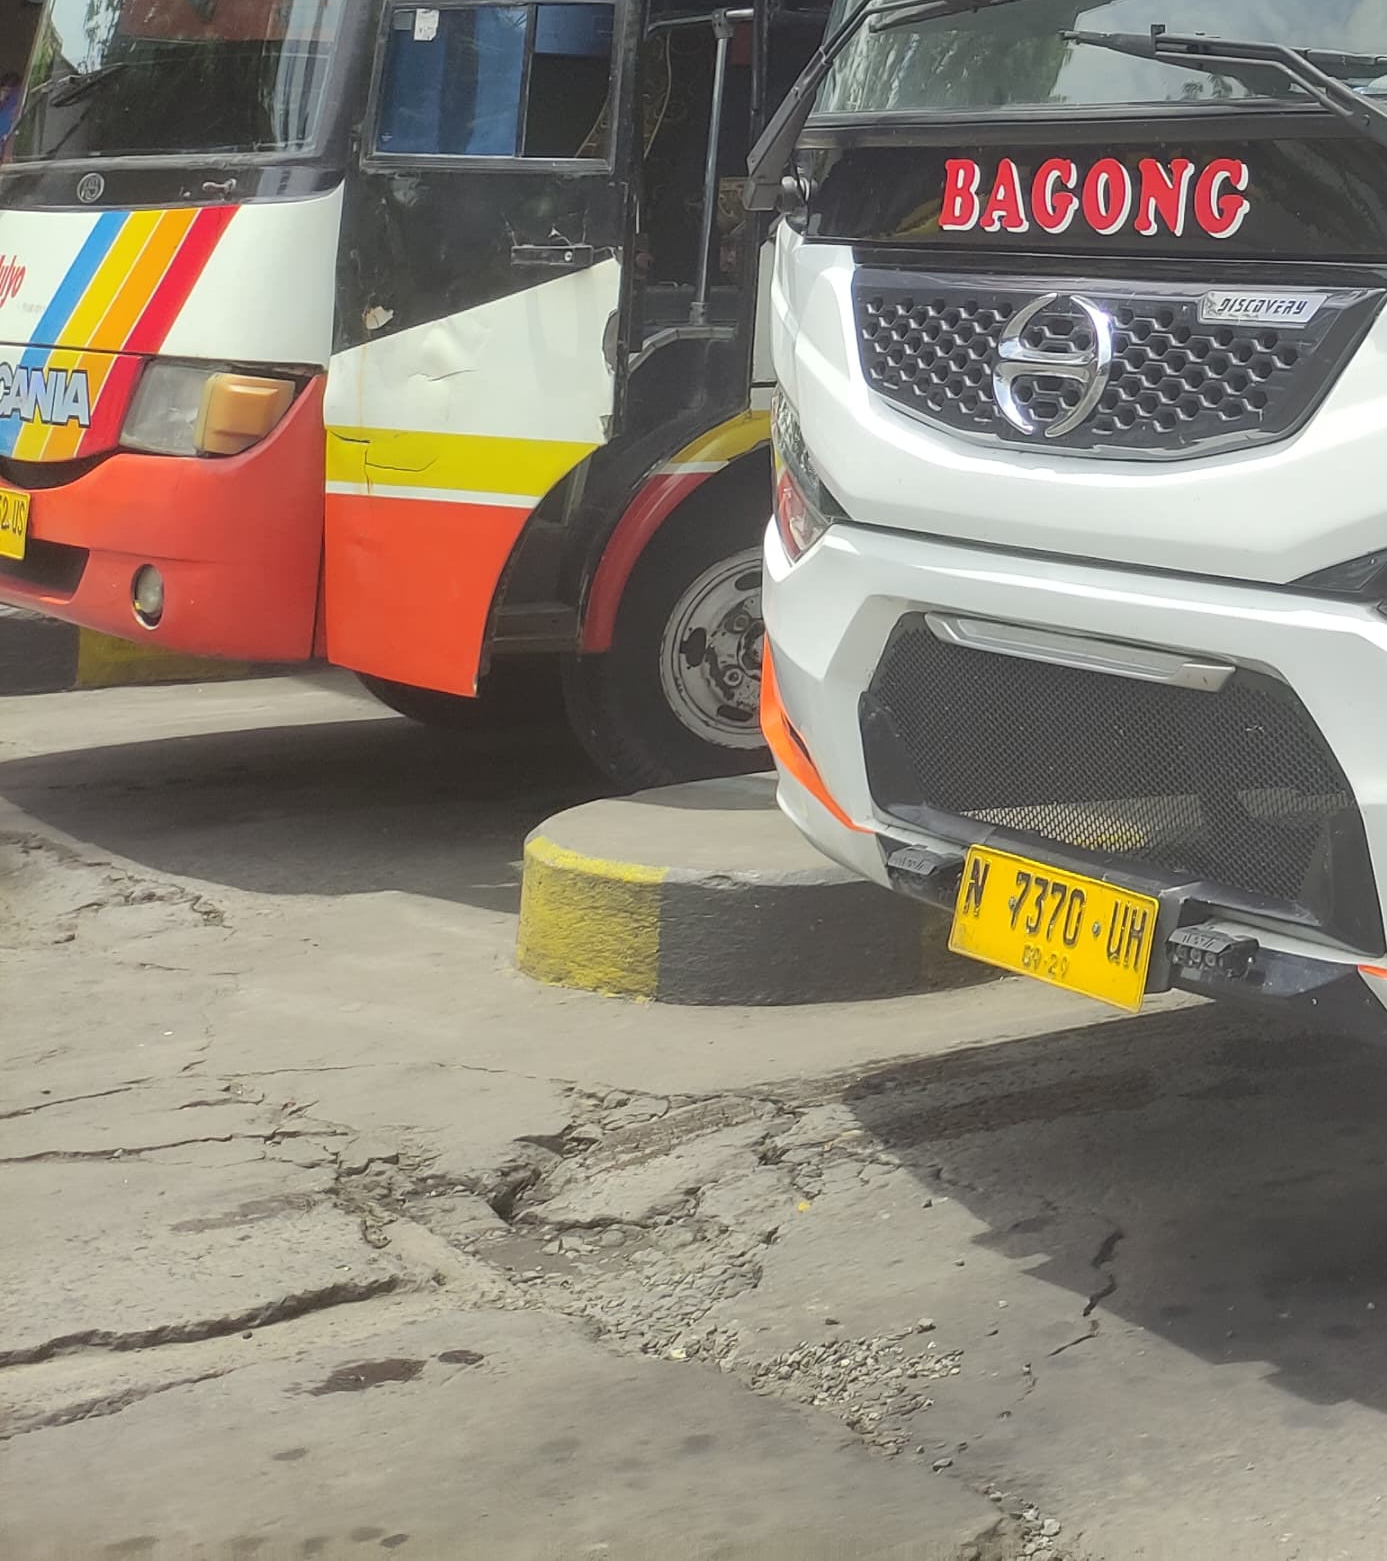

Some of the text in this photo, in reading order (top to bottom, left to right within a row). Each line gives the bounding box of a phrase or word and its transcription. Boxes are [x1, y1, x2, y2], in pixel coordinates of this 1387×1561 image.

[937, 157, 1250, 239] BAGONG
[963, 857, 1149, 972] N 7370 UH
